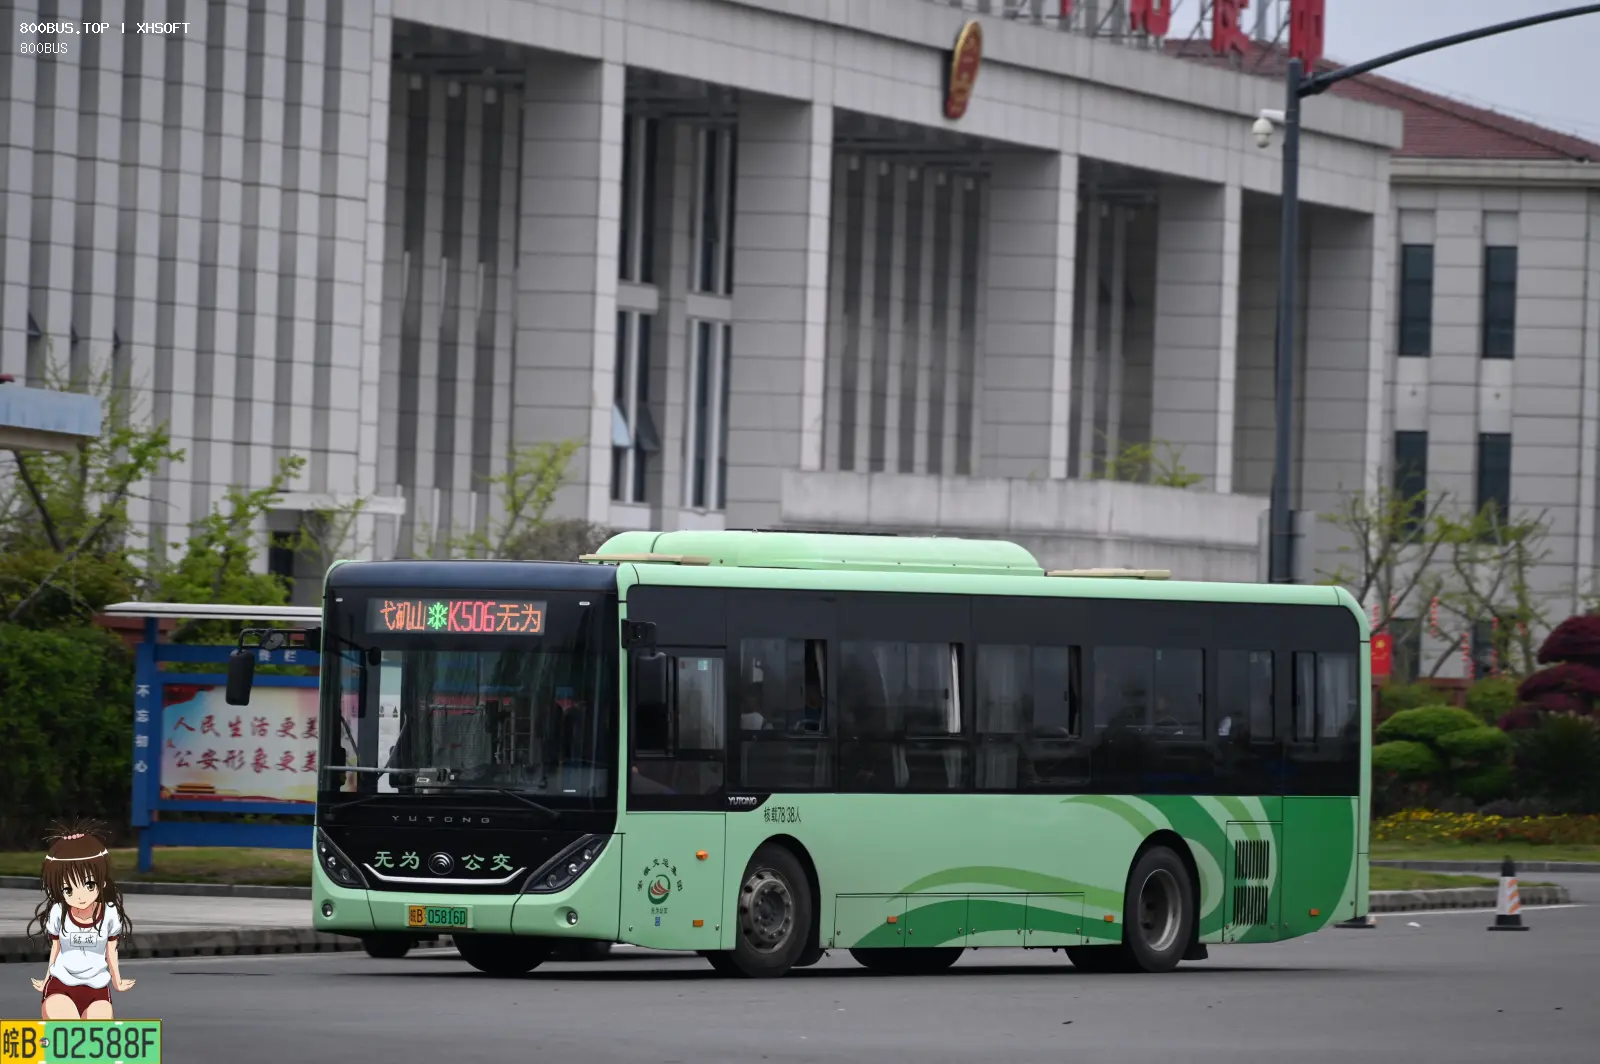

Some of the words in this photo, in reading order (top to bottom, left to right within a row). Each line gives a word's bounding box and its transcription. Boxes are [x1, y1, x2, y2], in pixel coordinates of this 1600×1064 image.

[448, 601, 496, 632] K506
[496, 603, 541, 632] 无为
[728, 796, 758, 806] YUTONG
[392, 815, 491, 824] YUTONG
[373, 851, 420, 870] 无为
[461, 853, 514, 871] 公交
[428, 909, 466, 925] 05816D
